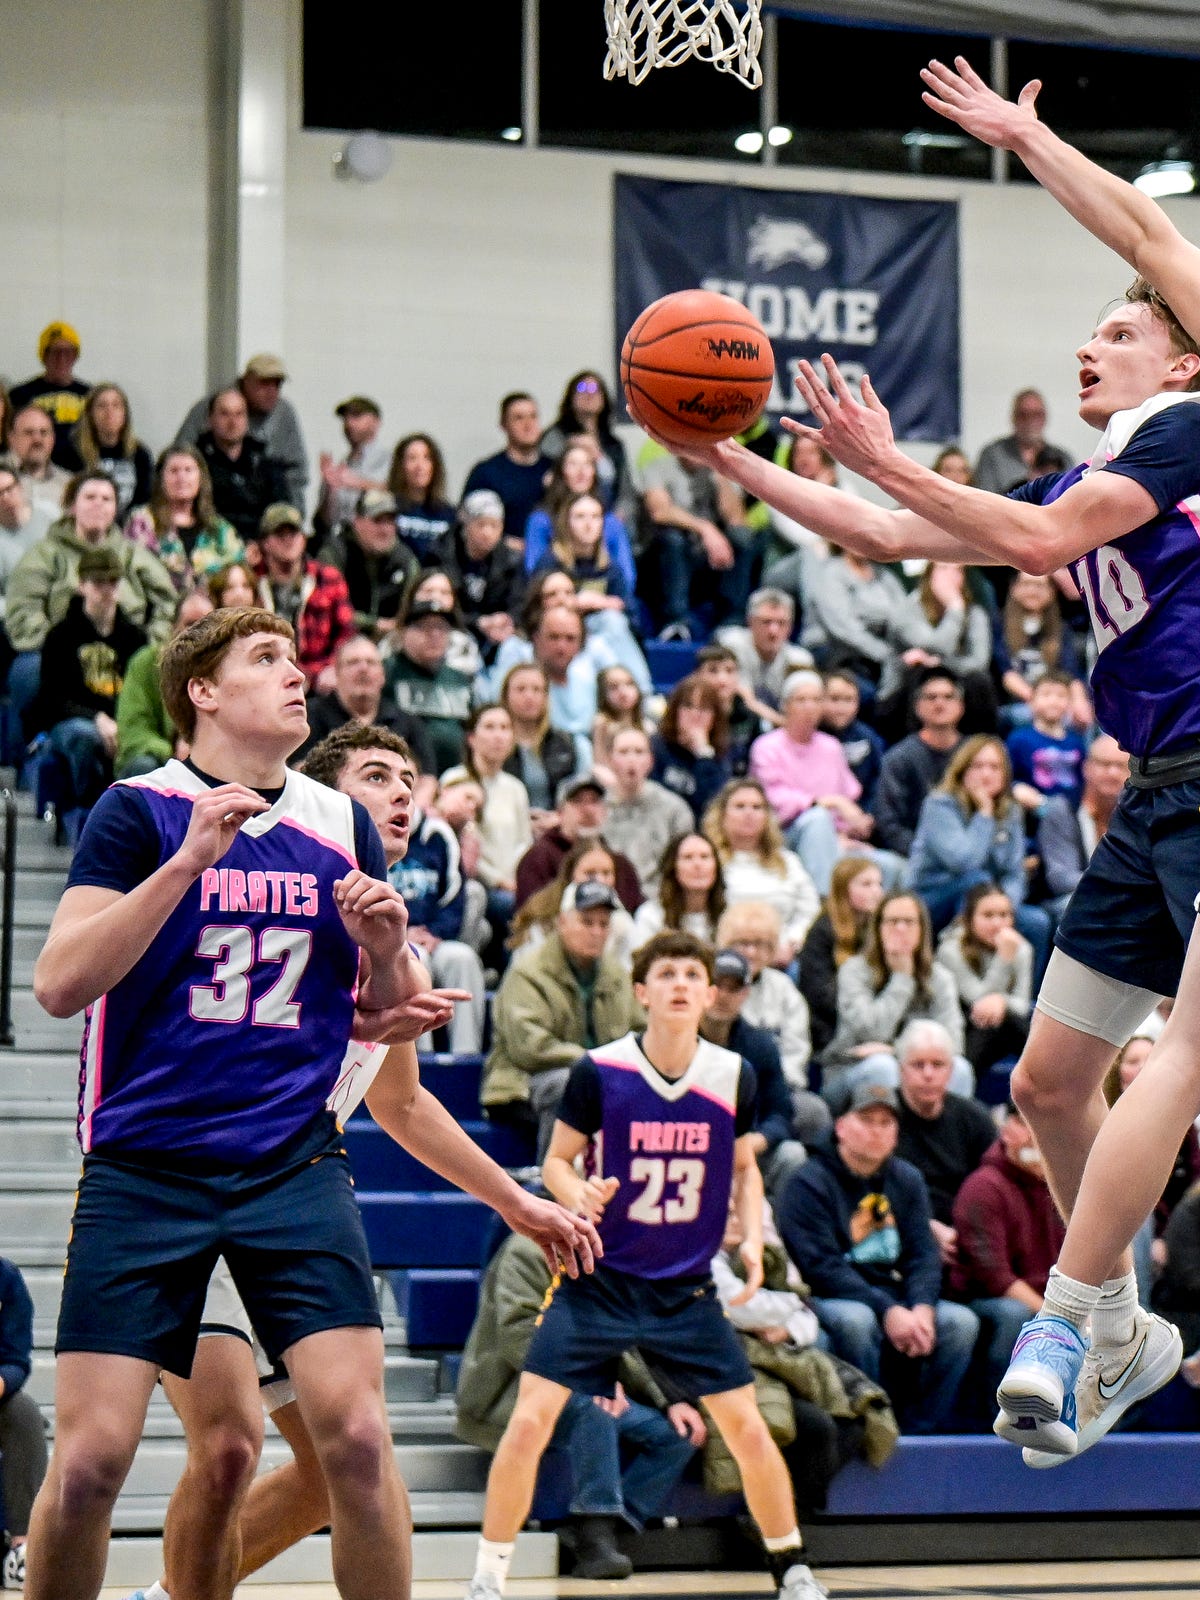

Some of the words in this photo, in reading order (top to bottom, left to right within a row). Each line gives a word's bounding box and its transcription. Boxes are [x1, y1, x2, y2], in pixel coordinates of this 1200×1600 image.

[200, 867, 319, 917] PIRATES
[189, 924, 313, 1029] 32
[629, 1120, 711, 1154] PIRATES
[627, 1157, 706, 1226] 23
